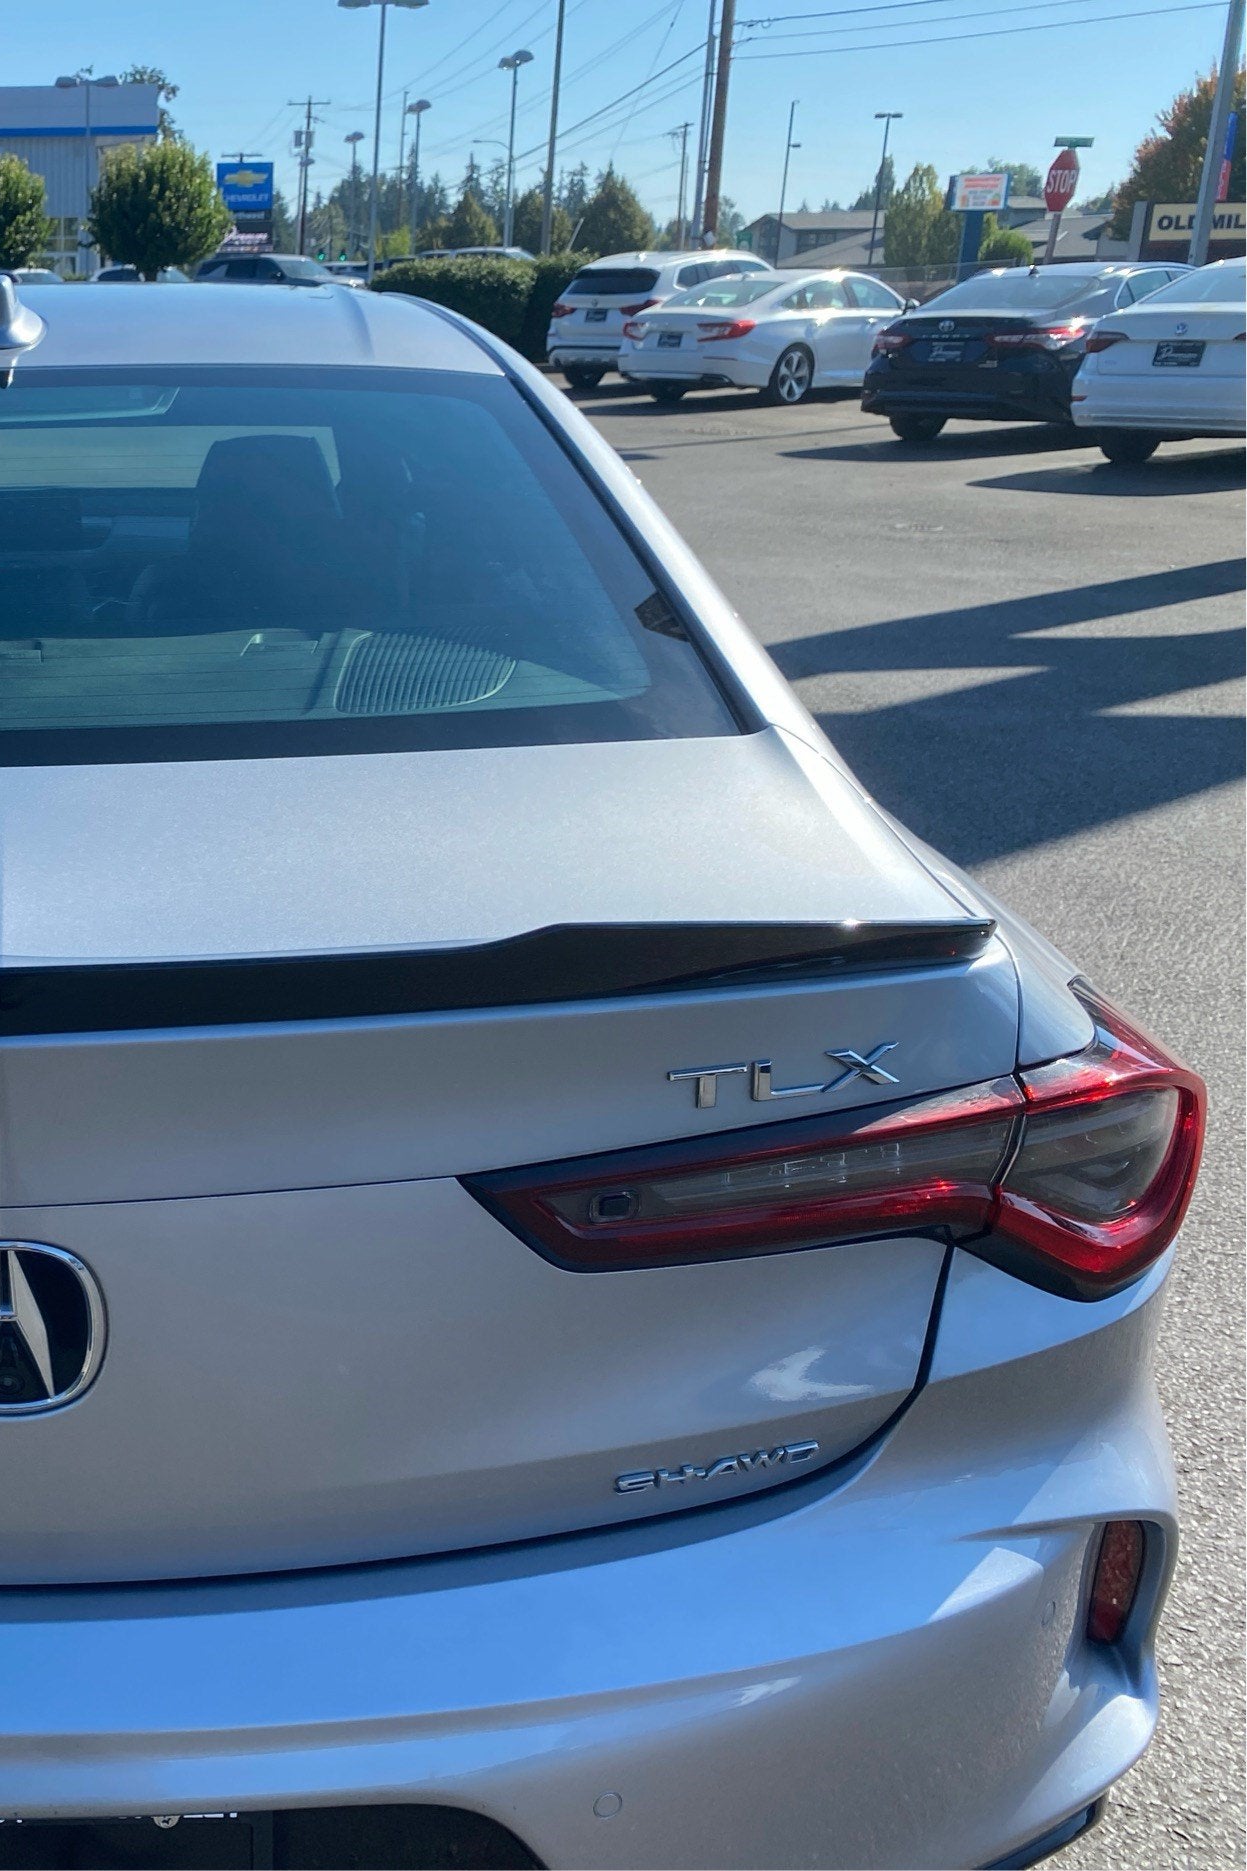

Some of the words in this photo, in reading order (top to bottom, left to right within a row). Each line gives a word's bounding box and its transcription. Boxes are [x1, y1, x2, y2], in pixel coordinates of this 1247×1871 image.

[225, 194, 269, 202] HEVROLET
[1047, 169, 1079, 193] STOP
[666, 1041, 901, 1109] TLX
[614, 1440, 820, 1496] SH-AWD
